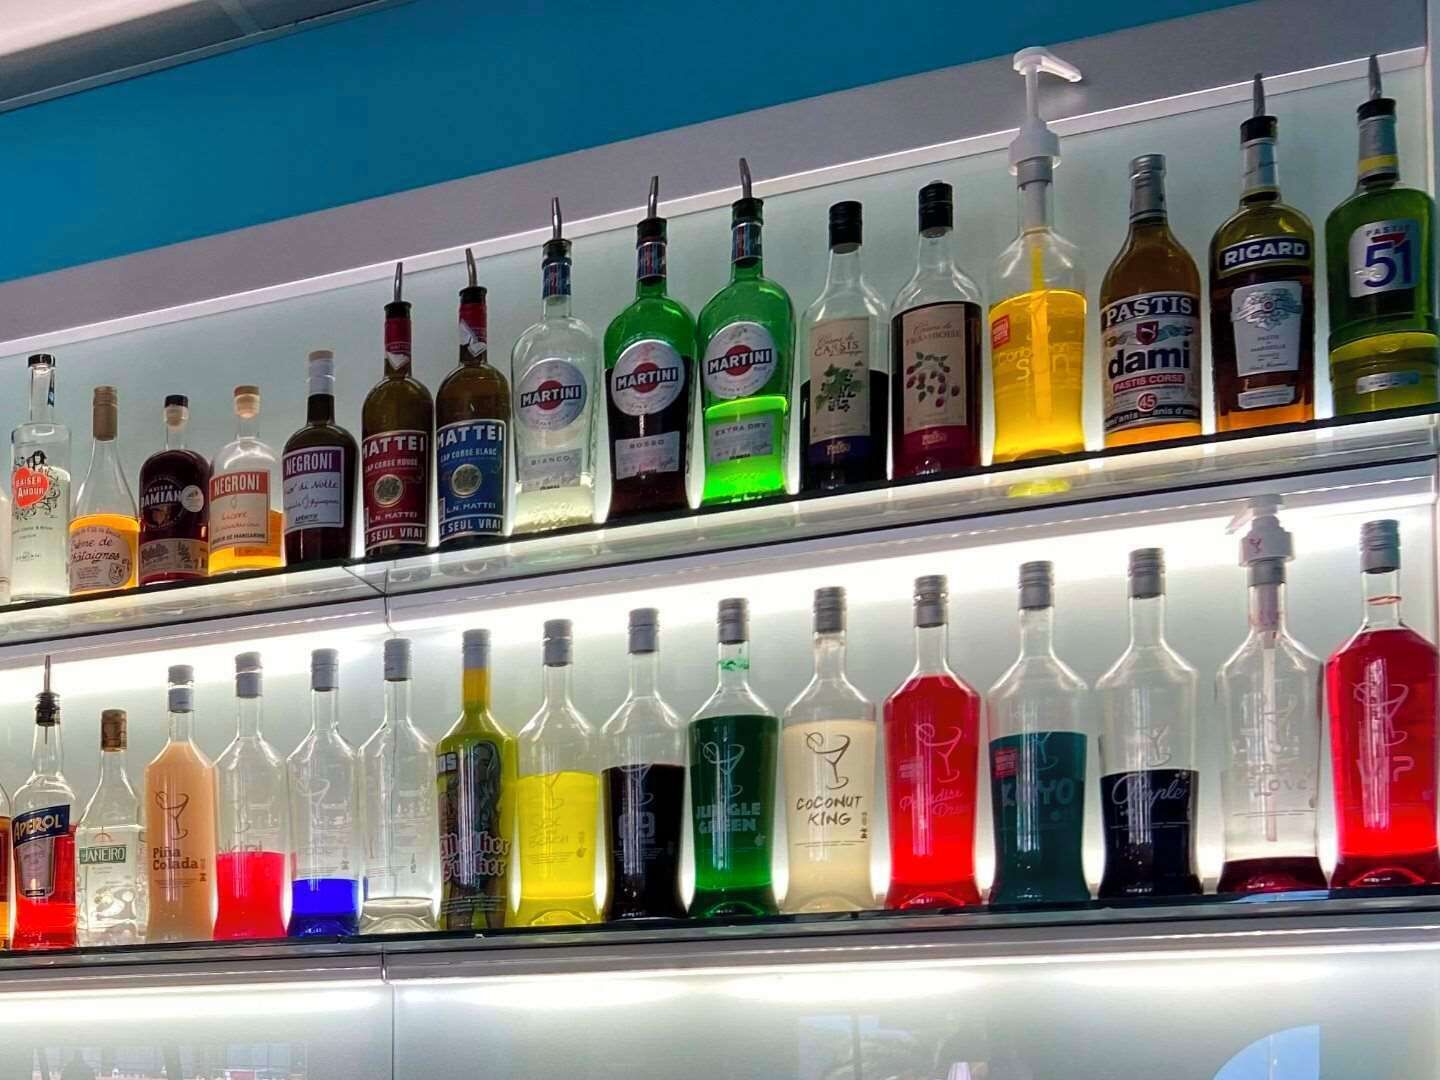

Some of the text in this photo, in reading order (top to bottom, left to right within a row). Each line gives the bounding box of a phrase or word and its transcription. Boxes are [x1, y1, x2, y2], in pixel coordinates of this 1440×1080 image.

[1224, 241, 1305, 266] RICARD
[1363, 239, 1410, 288] 51
[1106, 296, 1192, 325] PASTIS
[709, 350, 771, 374] MARTINI
[1108, 340, 1190, 379] dami
[617, 368, 677, 390] MARTINI
[1113, 374, 1184, 391] PASTIS CORSE
[522, 386, 581, 406] MARTINI
[1139, 395, 1155, 409] 45
[715, 424, 745, 436] EXTRA
[285, 451, 333, 475] NEGRONI
[214, 474, 260, 496] NEGRONI
[463, 502, 496, 510] MATTEI
[385, 511, 417, 520] MATTEI
[448, 520, 473, 532] SEUL
[478, 518, 501, 529] VRAI
[371, 528, 423, 541] SEUL VRAI
[1356, 755, 1415, 785] VP
[796, 795, 863, 811] COCONUT
[14, 813, 63, 839] APEROL
[808, 812, 852, 827] KING
[82, 847, 126, 862] JANEIRO
[152, 857, 199, 871] Colada
